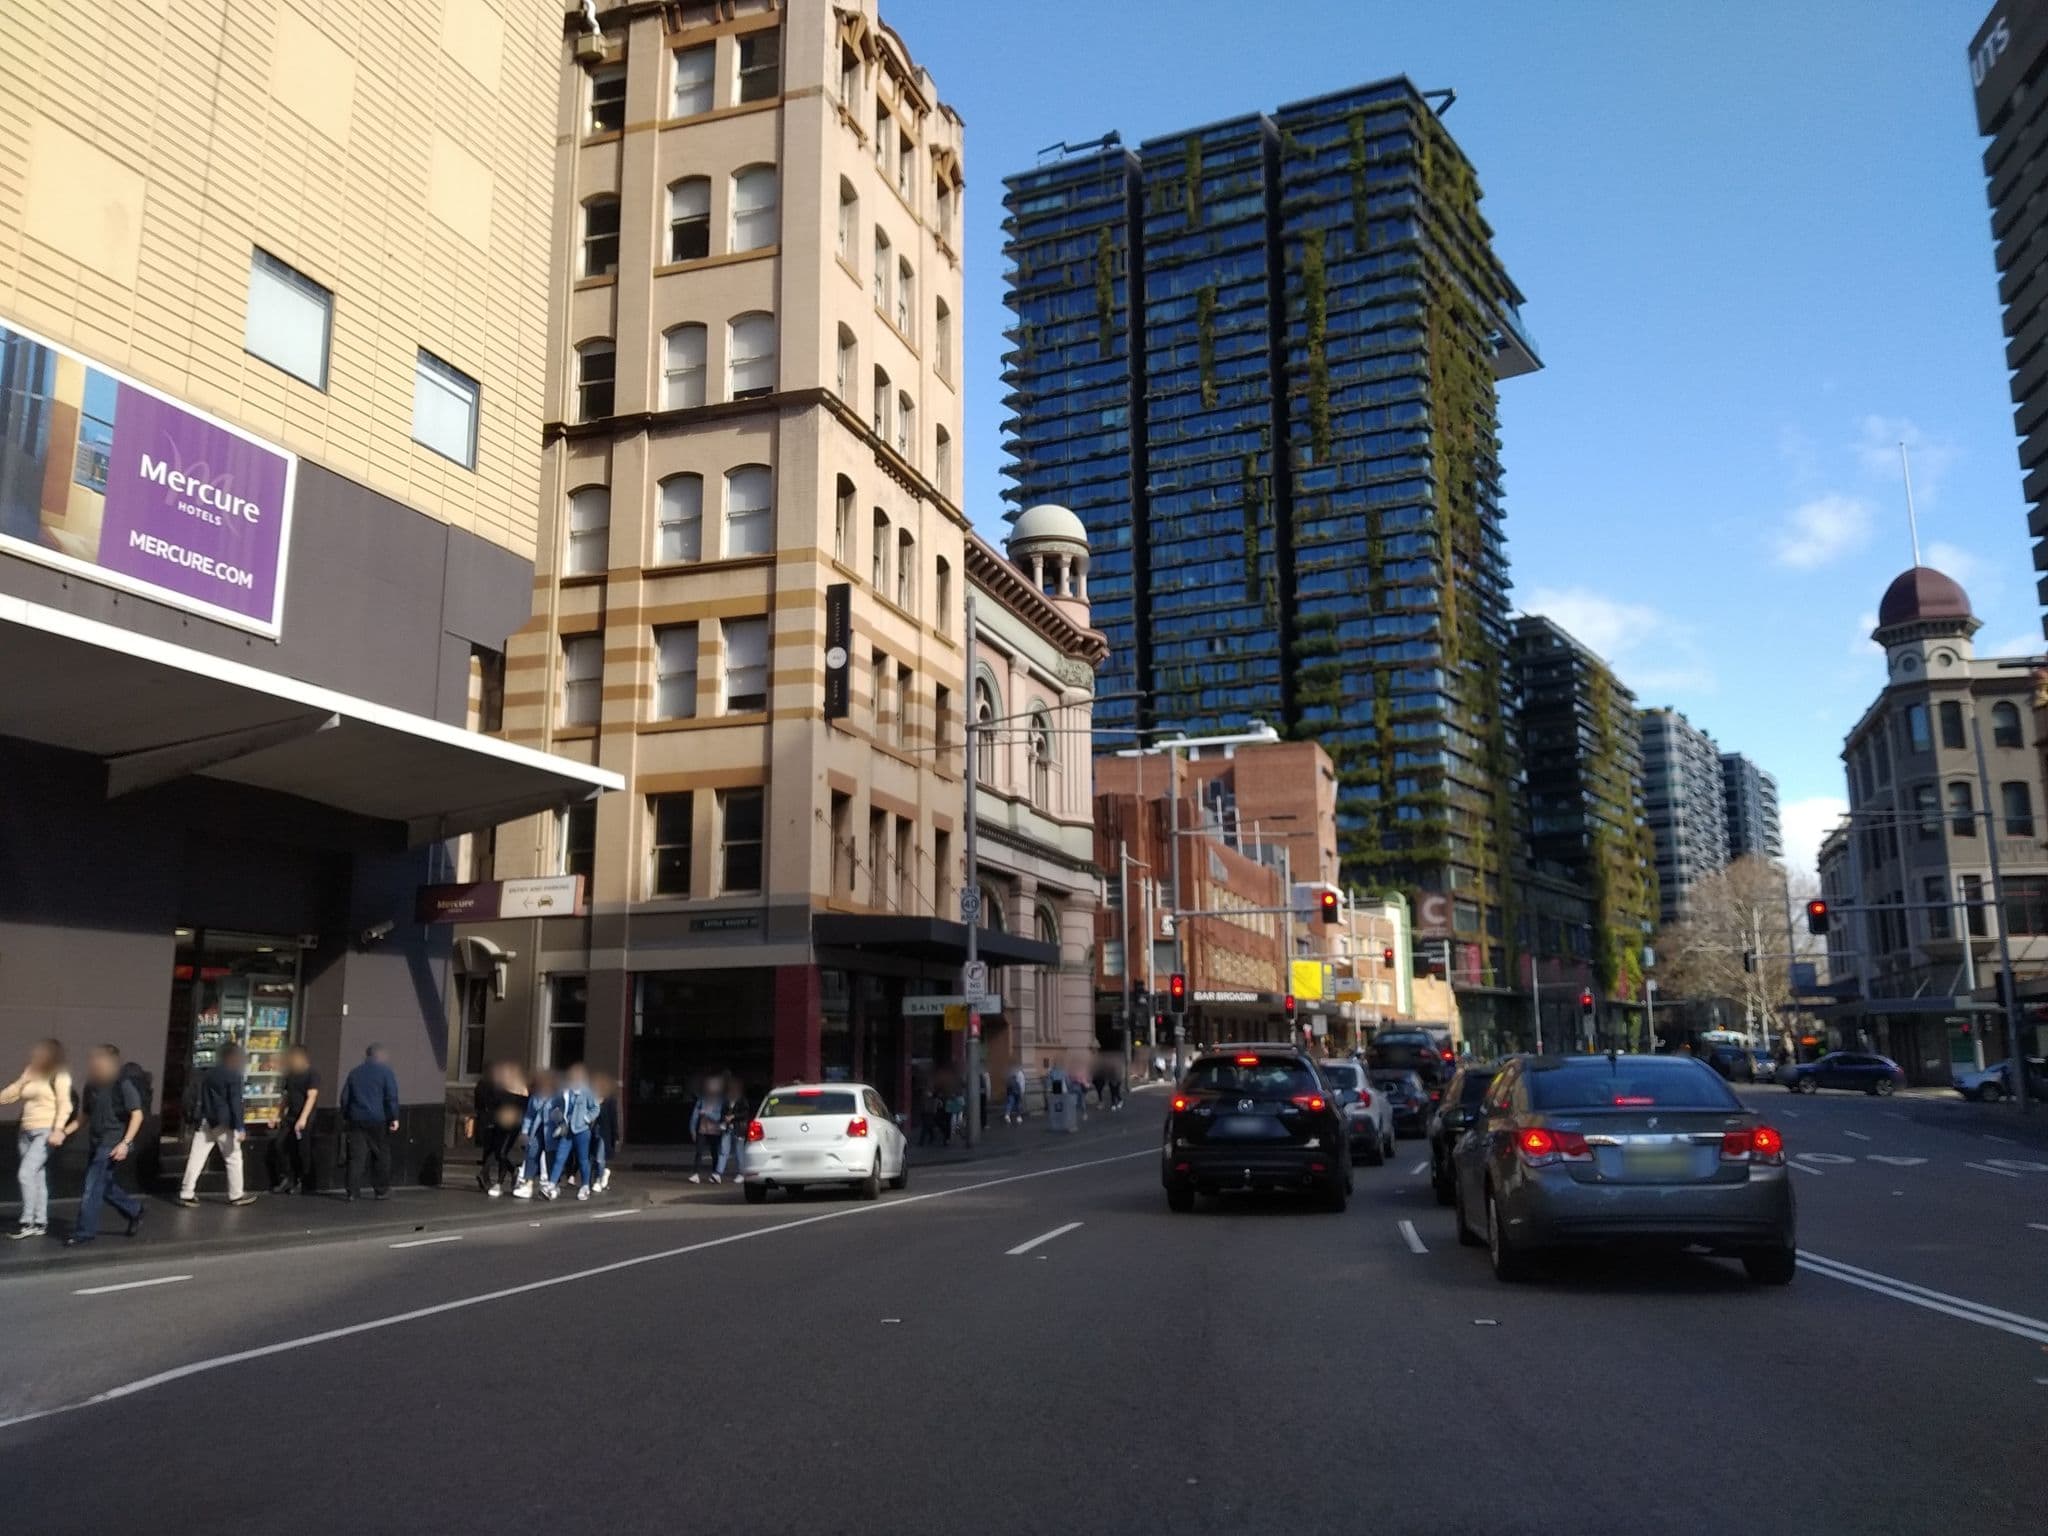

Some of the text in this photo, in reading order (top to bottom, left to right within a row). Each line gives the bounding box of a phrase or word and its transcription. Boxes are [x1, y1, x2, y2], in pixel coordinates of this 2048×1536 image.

[1972, 16, 2010, 87] UTS
[140, 453, 260, 523] Mercure
[177, 501, 222, 526] HOTELS
[129, 529, 253, 589] MERCURE.COM
[437, 899, 475, 909] Mercure
[964, 899, 977, 910] 40
